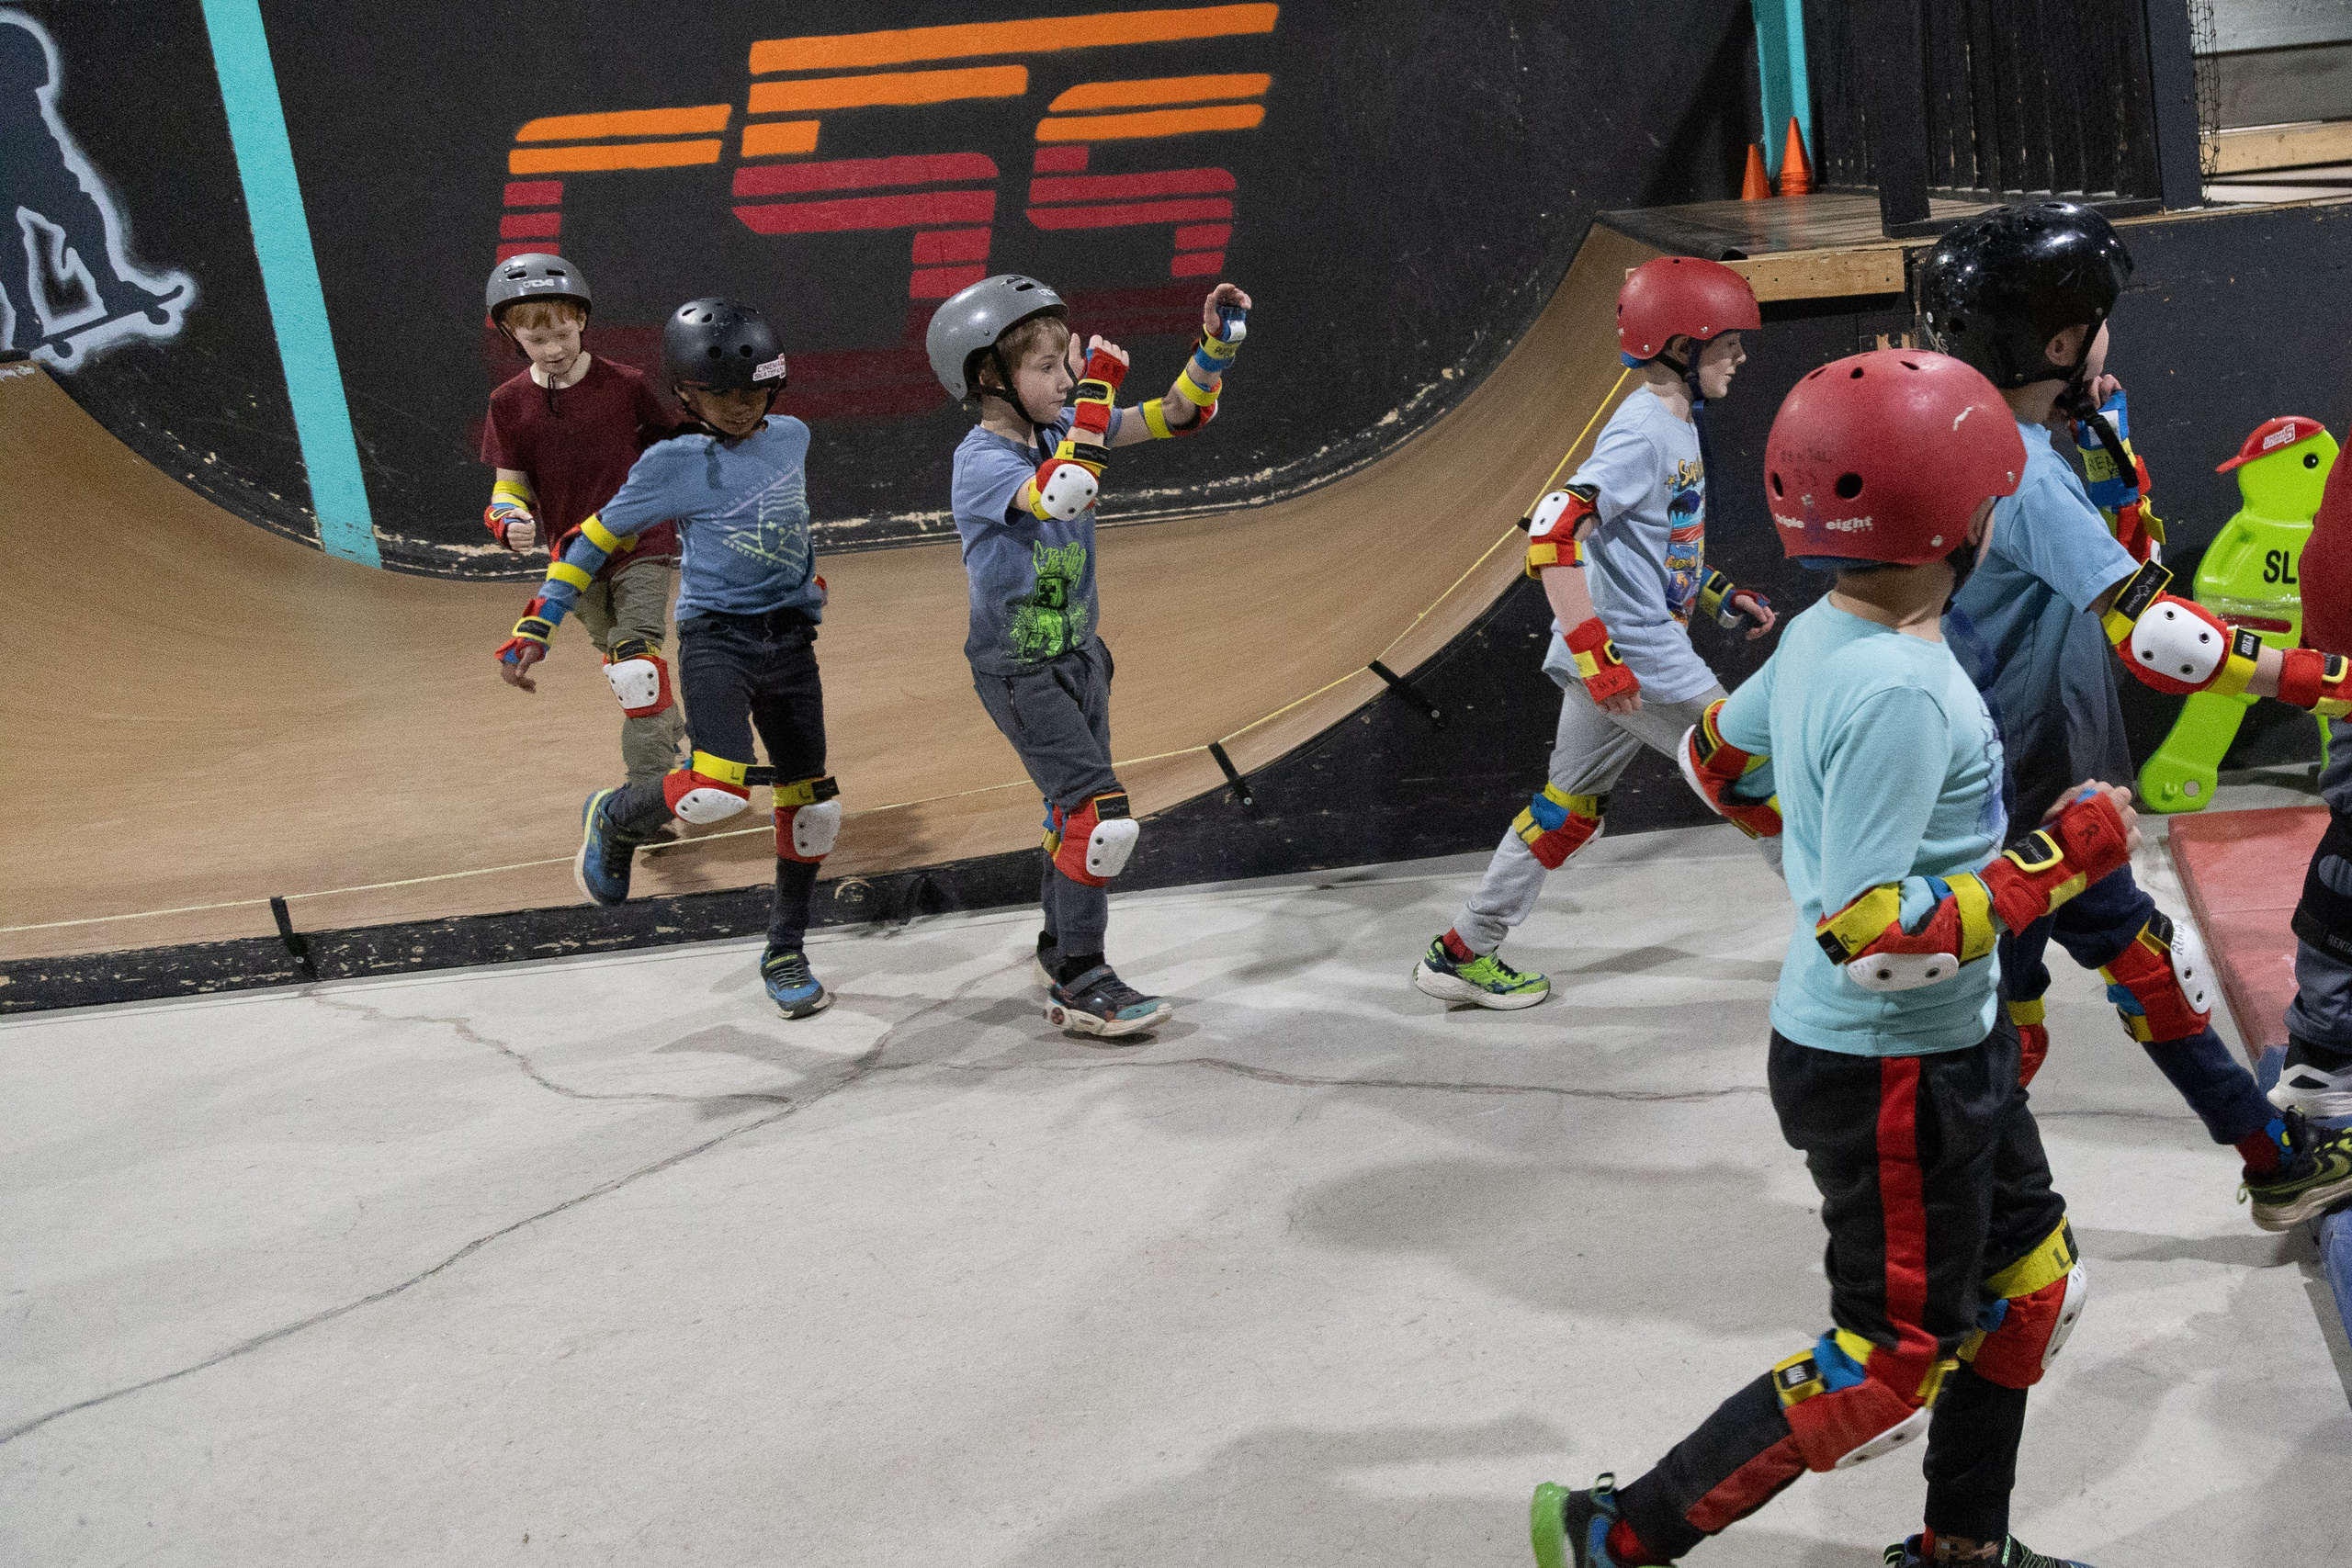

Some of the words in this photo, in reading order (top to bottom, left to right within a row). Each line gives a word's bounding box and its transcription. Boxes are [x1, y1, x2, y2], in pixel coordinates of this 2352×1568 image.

[1774, 513, 1804, 528] triple
[1826, 516, 1873, 532] eight
[2263, 549, 2297, 584] SL
[2078, 823, 2100, 846] R
[1838, 931, 1858, 950] R
[2052, 1248, 2070, 1269] L
